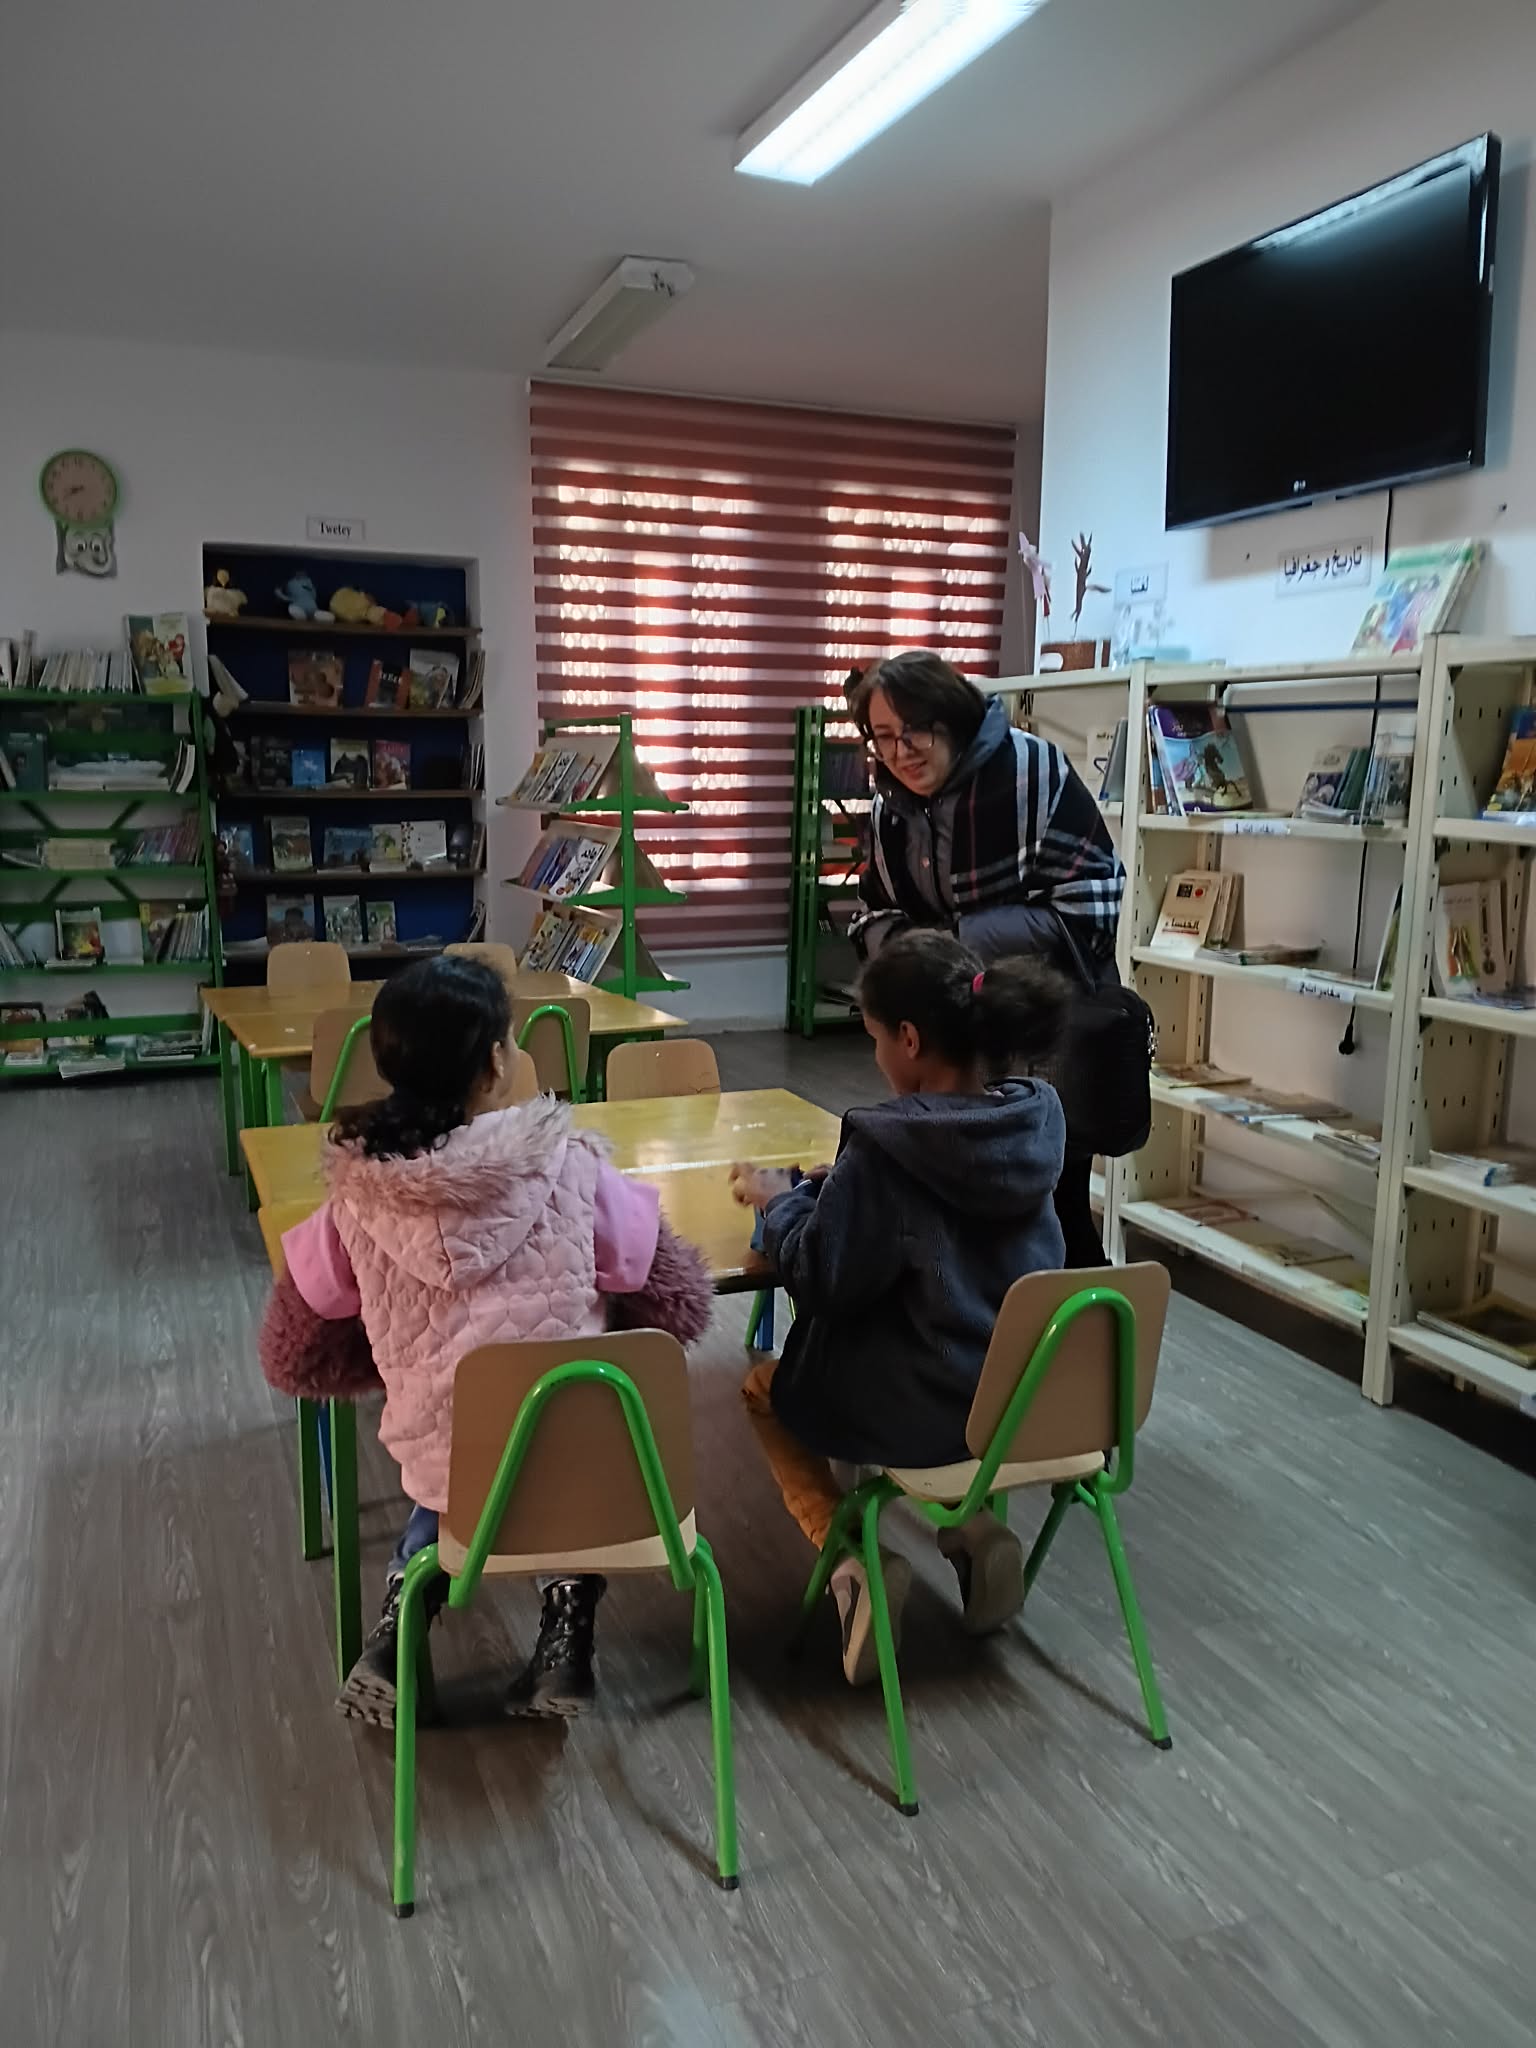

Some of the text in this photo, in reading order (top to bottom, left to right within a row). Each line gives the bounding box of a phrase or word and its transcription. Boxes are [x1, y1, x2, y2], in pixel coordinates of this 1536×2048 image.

[1284, 545, 1362, 583] تاريخ و جغرافيا
